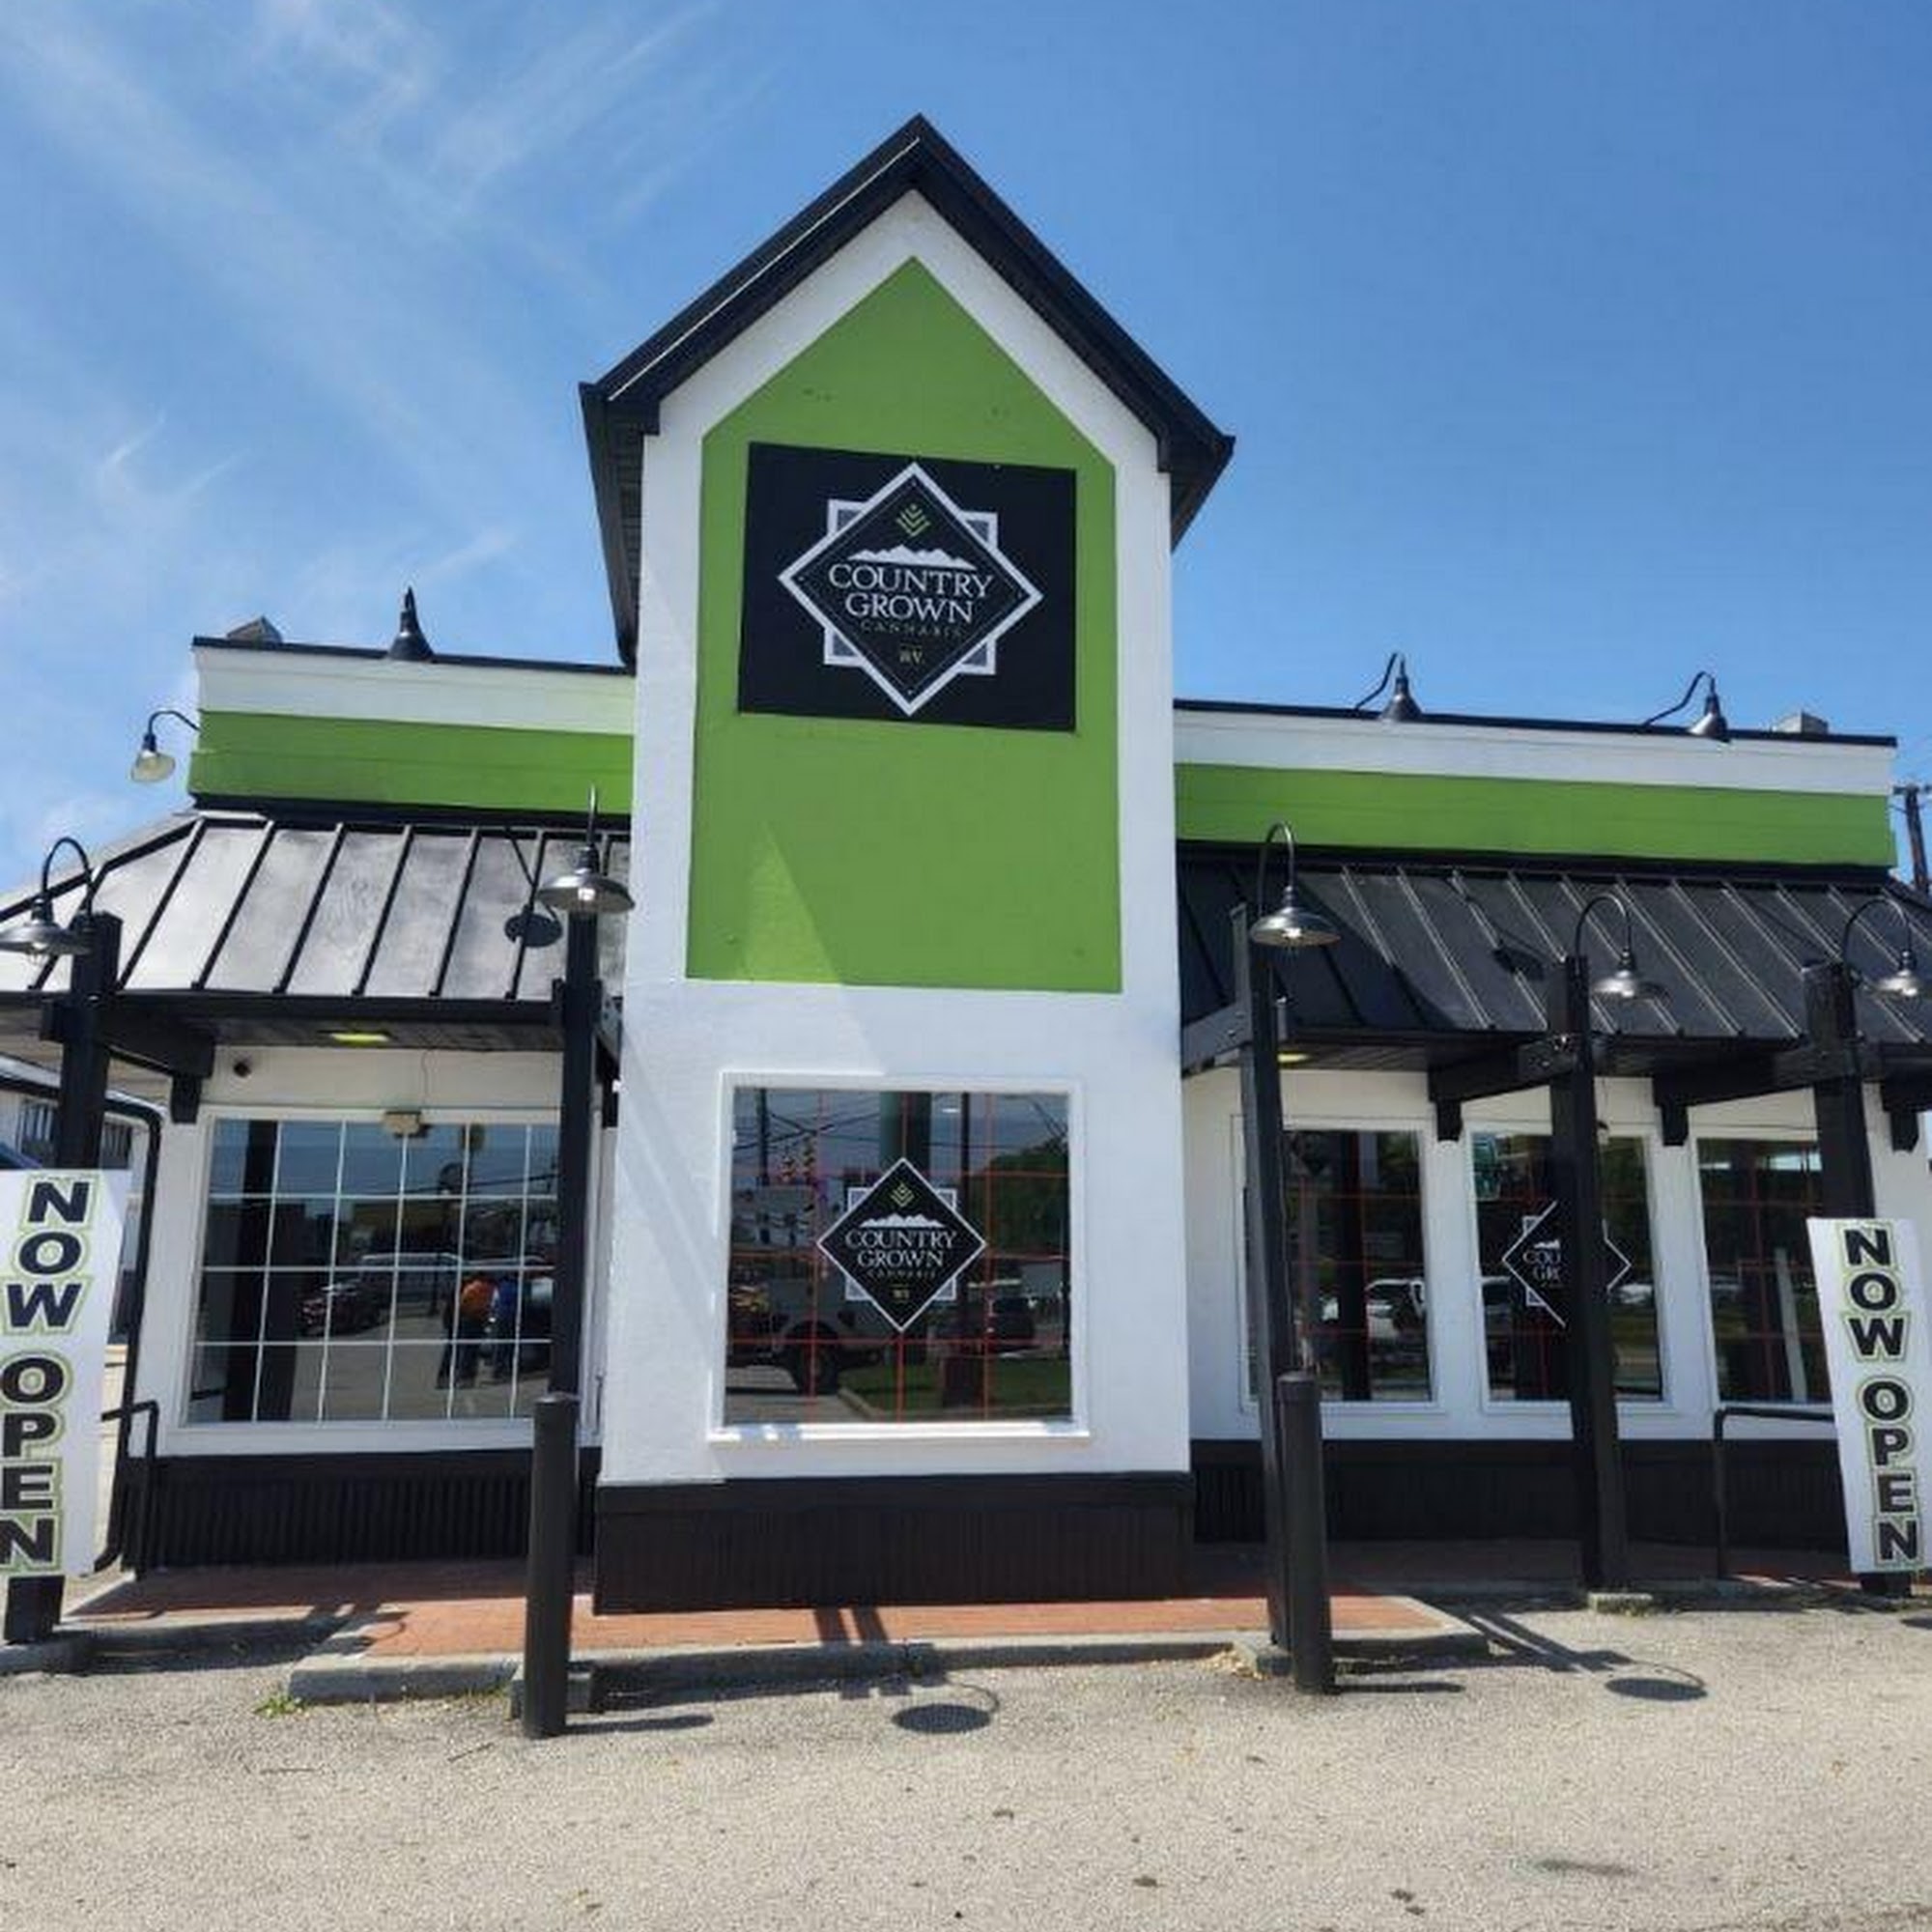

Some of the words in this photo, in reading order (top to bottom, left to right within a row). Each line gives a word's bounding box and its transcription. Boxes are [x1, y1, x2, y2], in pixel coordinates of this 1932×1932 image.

[829, 564, 993, 599] COUNTRY
[845, 592, 974, 624] GROWN
[6, 1180, 90, 1328] NOW
[845, 1230, 956, 1249] COUNTRY
[857, 1249, 944, 1267] GROWN
[1843, 1228, 1905, 1356] NOW
[0, 1356, 65, 1563] OPEN
[1861, 1379, 1918, 1560] OPEN
